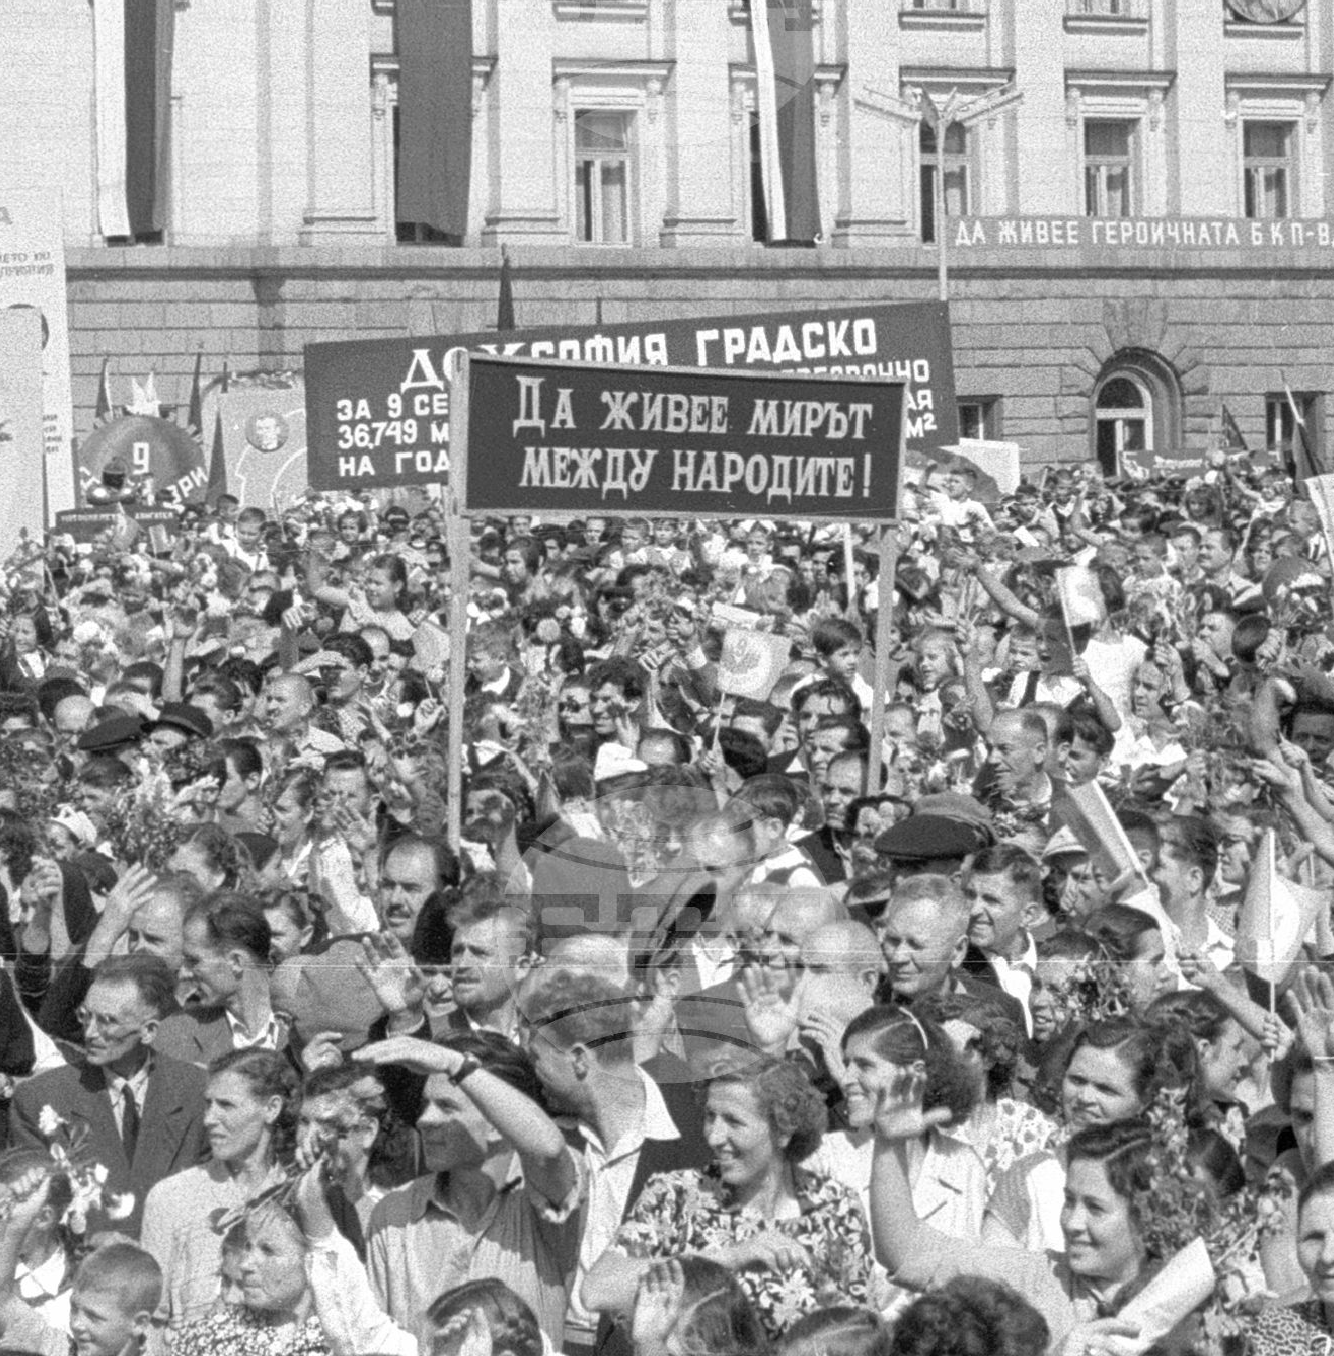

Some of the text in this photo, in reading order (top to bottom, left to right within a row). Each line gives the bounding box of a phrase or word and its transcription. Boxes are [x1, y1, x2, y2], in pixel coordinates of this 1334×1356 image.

[955, 220, 987, 246] ДА
[998, 220, 1079, 244] ЖИВЕЕ
[1092, 221, 1240, 245] ГЕРОИЧНАТА
[695, 318, 877, 366] ГРАДСКО
[336, 398, 372, 421] ЗА
[387, 393, 403, 418] 9
[512, 375, 873, 440] ДА ЖИВЕЕ МИРЪТ
[132, 441, 150, 475] 9
[338, 455, 376, 477] НА
[518, 446, 873, 505] МЕЖДУ НАРОДИТЕ!
